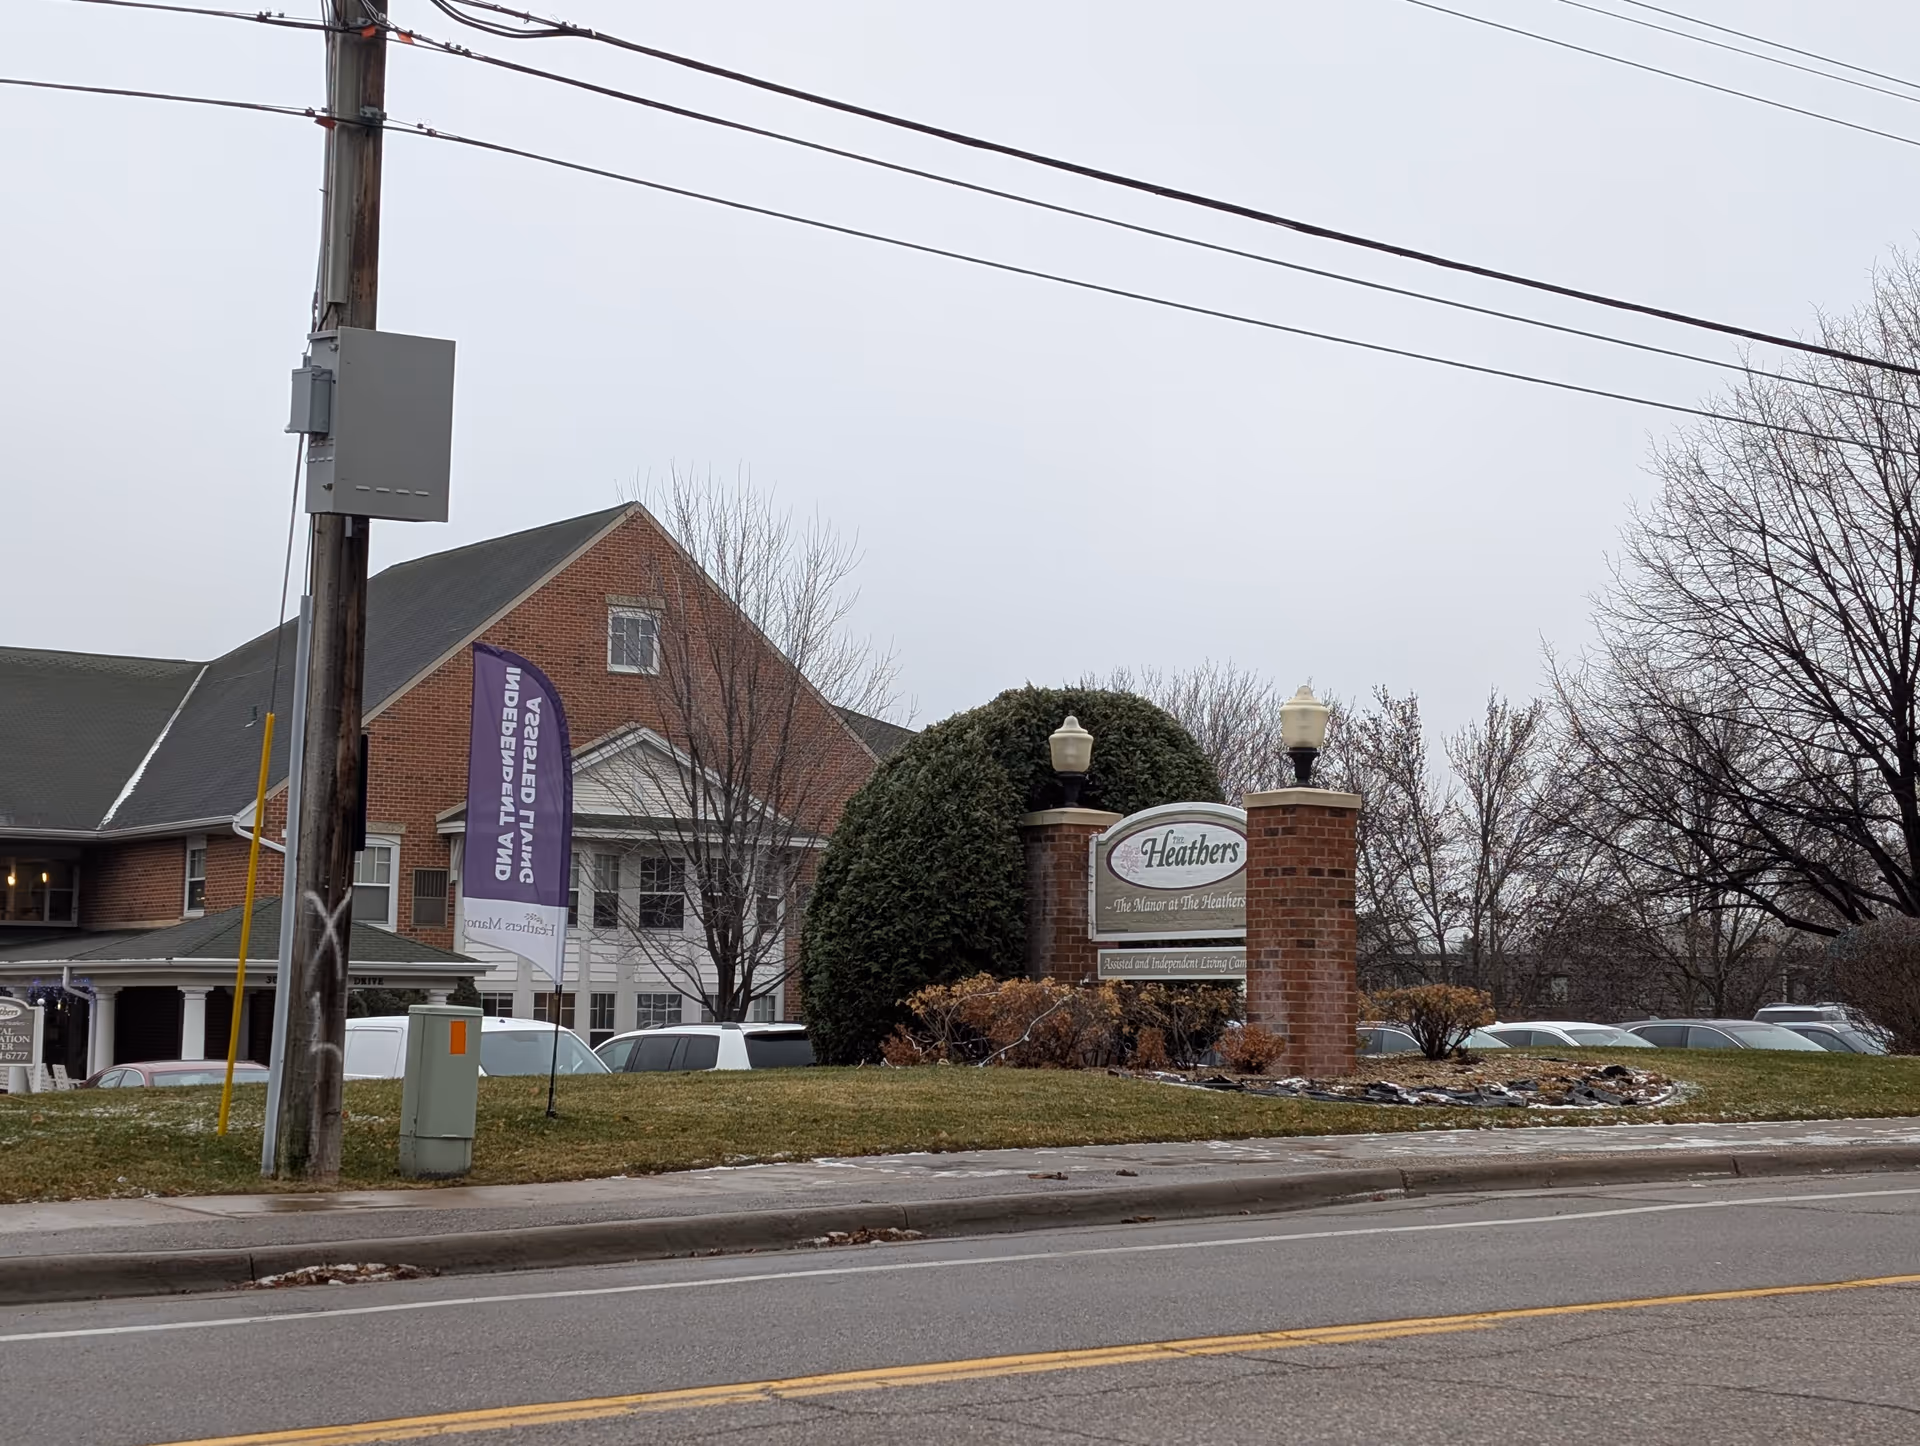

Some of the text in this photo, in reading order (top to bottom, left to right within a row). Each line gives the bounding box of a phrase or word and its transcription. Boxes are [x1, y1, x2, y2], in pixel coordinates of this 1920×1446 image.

[1140, 829, 1241, 868] Heathers
[1172, 836, 1185, 844] THE
[1114, 892, 1246, 913] The Manor at The Heathers
[1104, 956, 1133, 970] Assisted
[1135, 958, 1149, 969] and
[1151, 954, 1199, 973] Independent
[1200, 956, 1227, 973] Living
